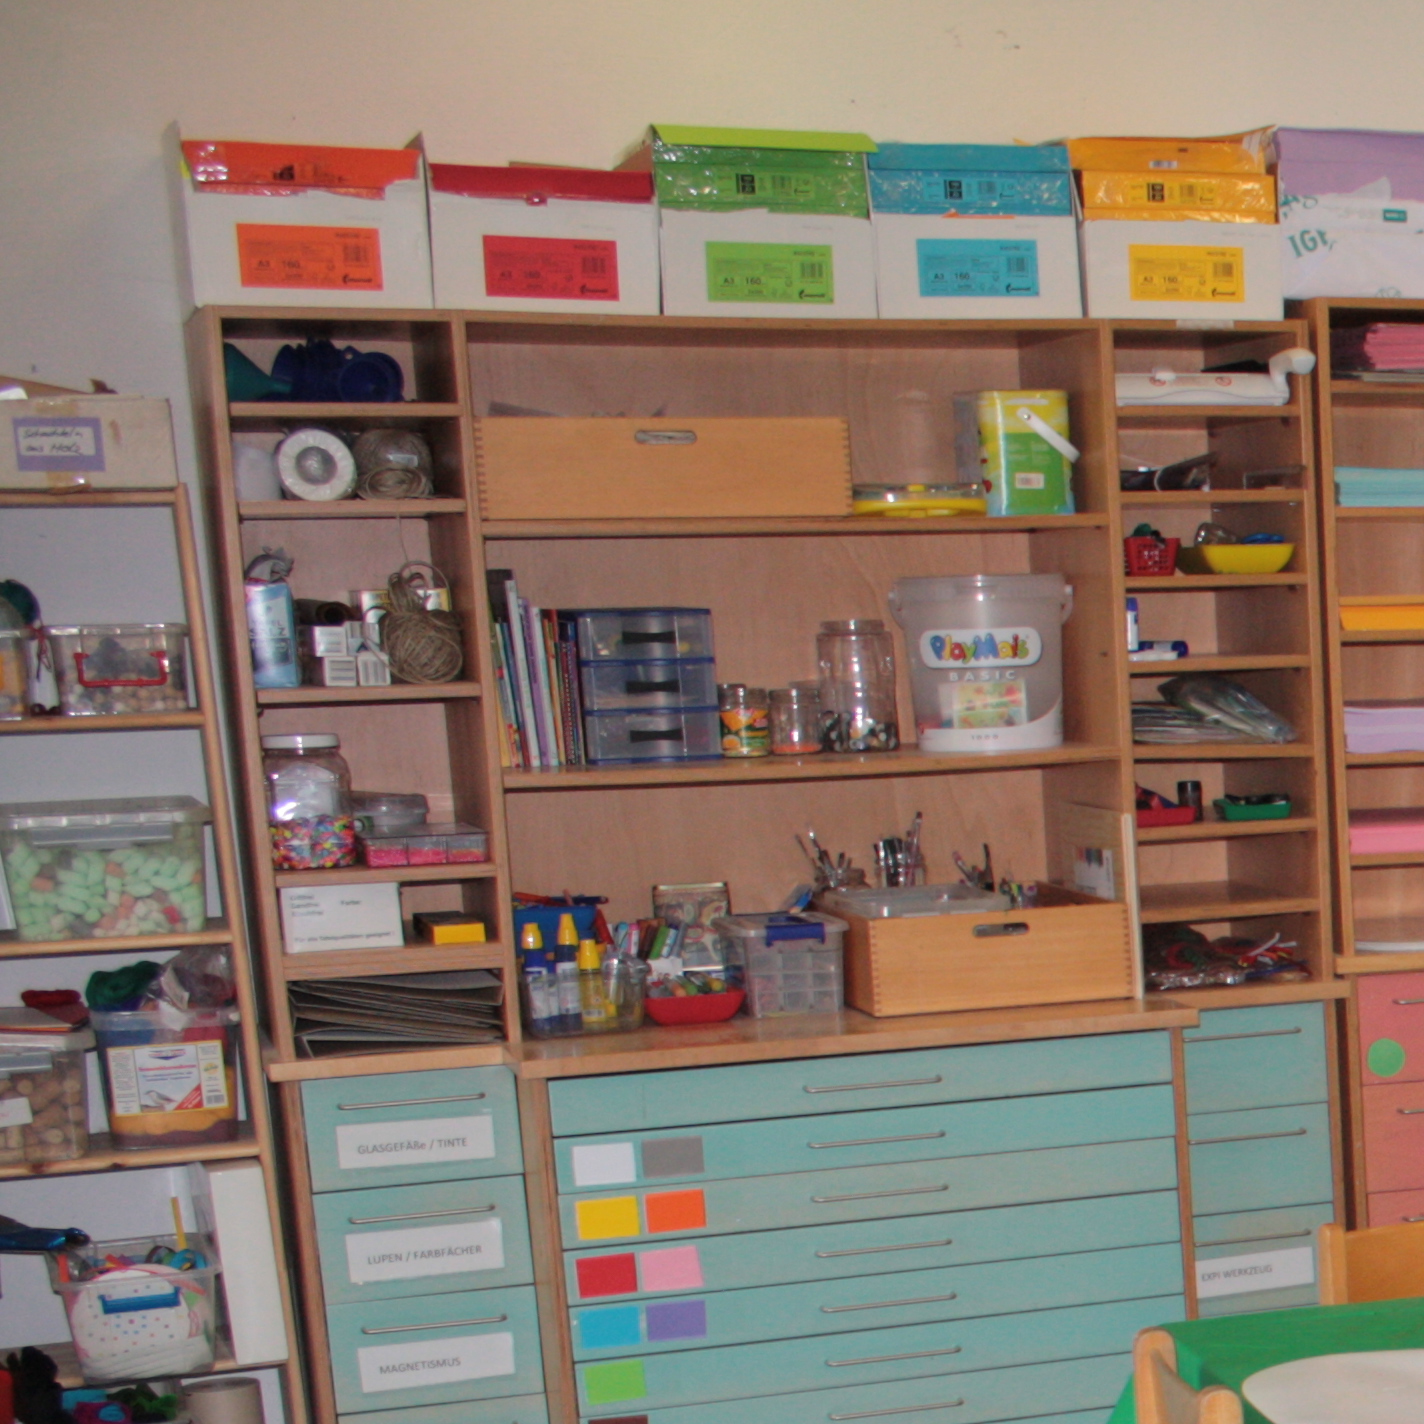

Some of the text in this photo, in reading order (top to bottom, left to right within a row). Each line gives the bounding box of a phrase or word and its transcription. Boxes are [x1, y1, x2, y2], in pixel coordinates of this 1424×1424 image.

[930, 633, 1029, 664] PlayMais
[950, 670, 1016, 682] BASIC
[437, 1137, 467, 1148] TINTE
[367, 1253, 403, 1265] LUPEN
[413, 1245, 483, 1260] FARBFÄCHER
[1201, 1265, 1273, 1282] EXPI WERKZEUG
